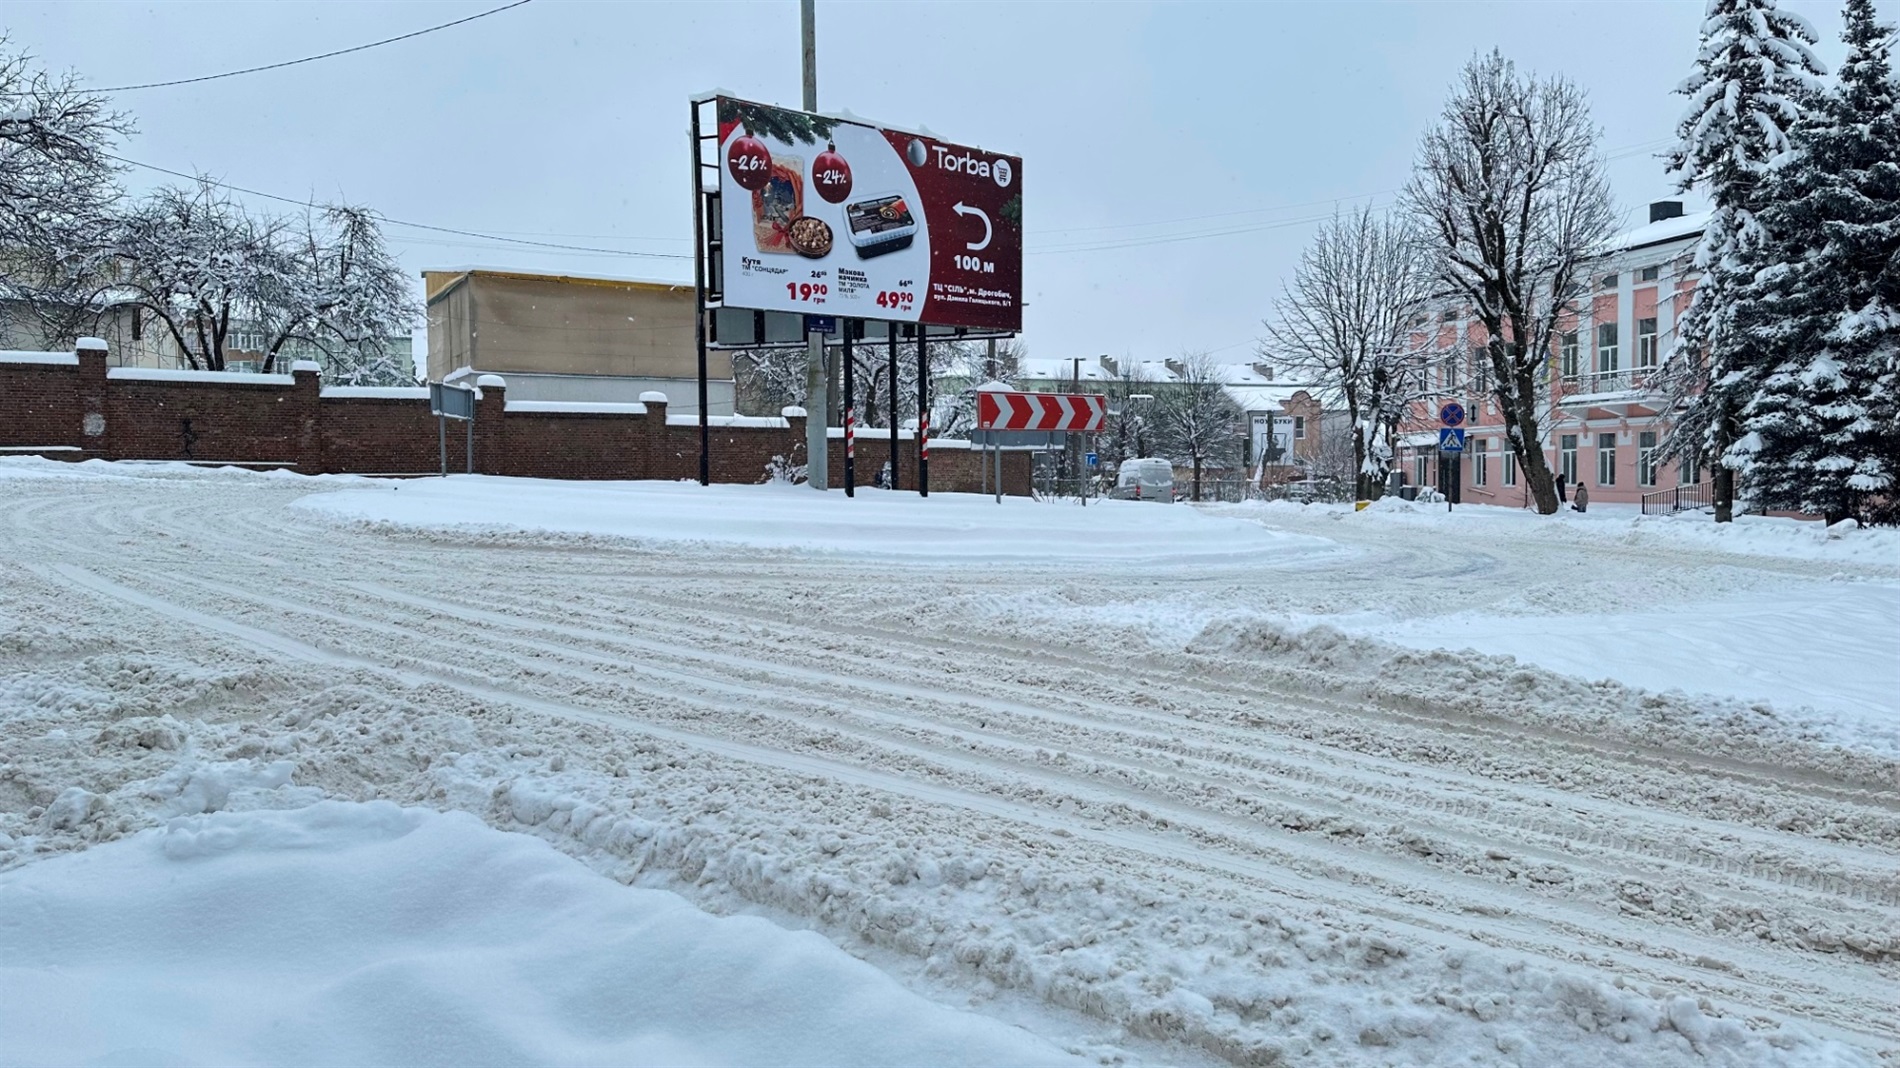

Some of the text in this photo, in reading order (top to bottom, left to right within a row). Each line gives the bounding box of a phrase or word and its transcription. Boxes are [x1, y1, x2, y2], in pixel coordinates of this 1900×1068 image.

[730, 155, 767, 171] -26%
[932, 145, 990, 177] Torba
[816, 169, 847, 185] -24%
[742, 256, 761, 265] Кутя
[954, 255, 980, 271] 100
[838, 267, 865, 277] Макова
[838, 275, 867, 283] начинка
[933, 283, 943, 292] ТЦ
[813, 296, 825, 304] грн
[900, 303, 912, 311] грн
